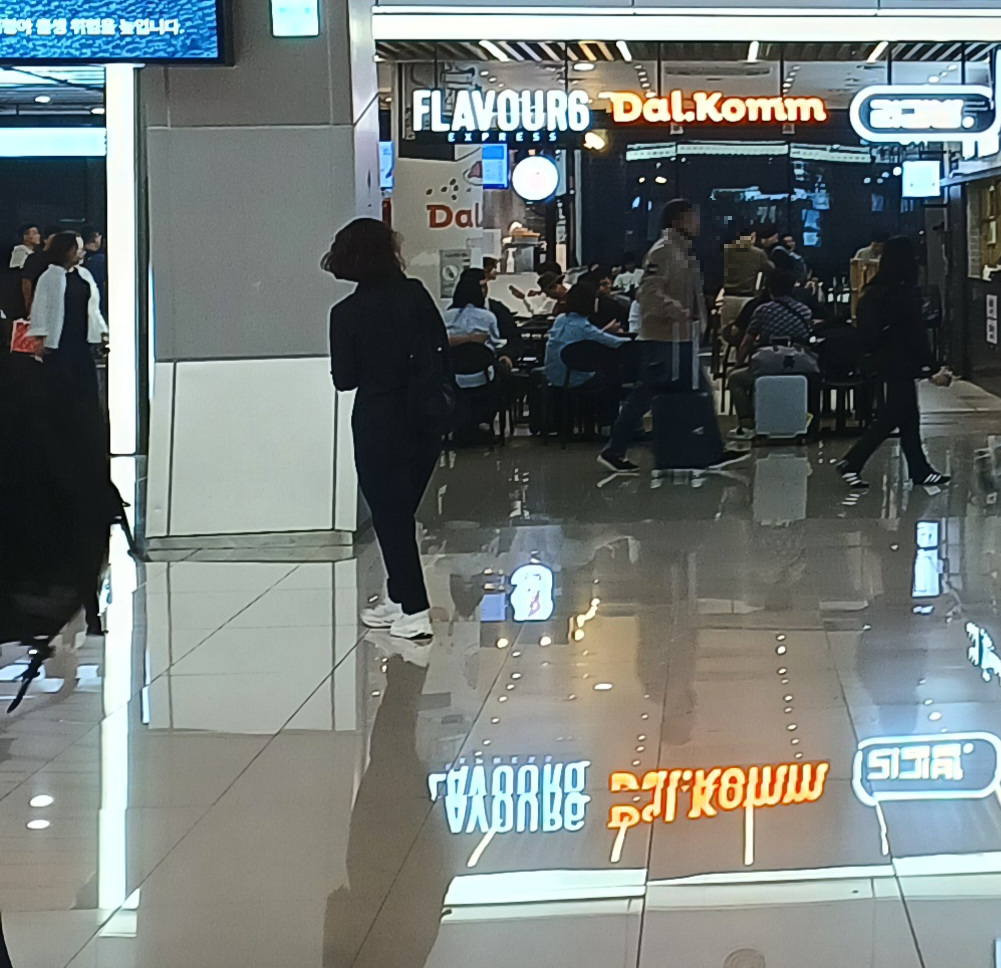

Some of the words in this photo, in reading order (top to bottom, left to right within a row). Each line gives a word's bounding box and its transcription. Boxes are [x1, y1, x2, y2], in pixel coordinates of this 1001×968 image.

[411, 88, 591, 134] FLAVOUR6
[608, 91, 828, 124] Dal.Komm
[447, 132, 558, 142] EXPRESS
